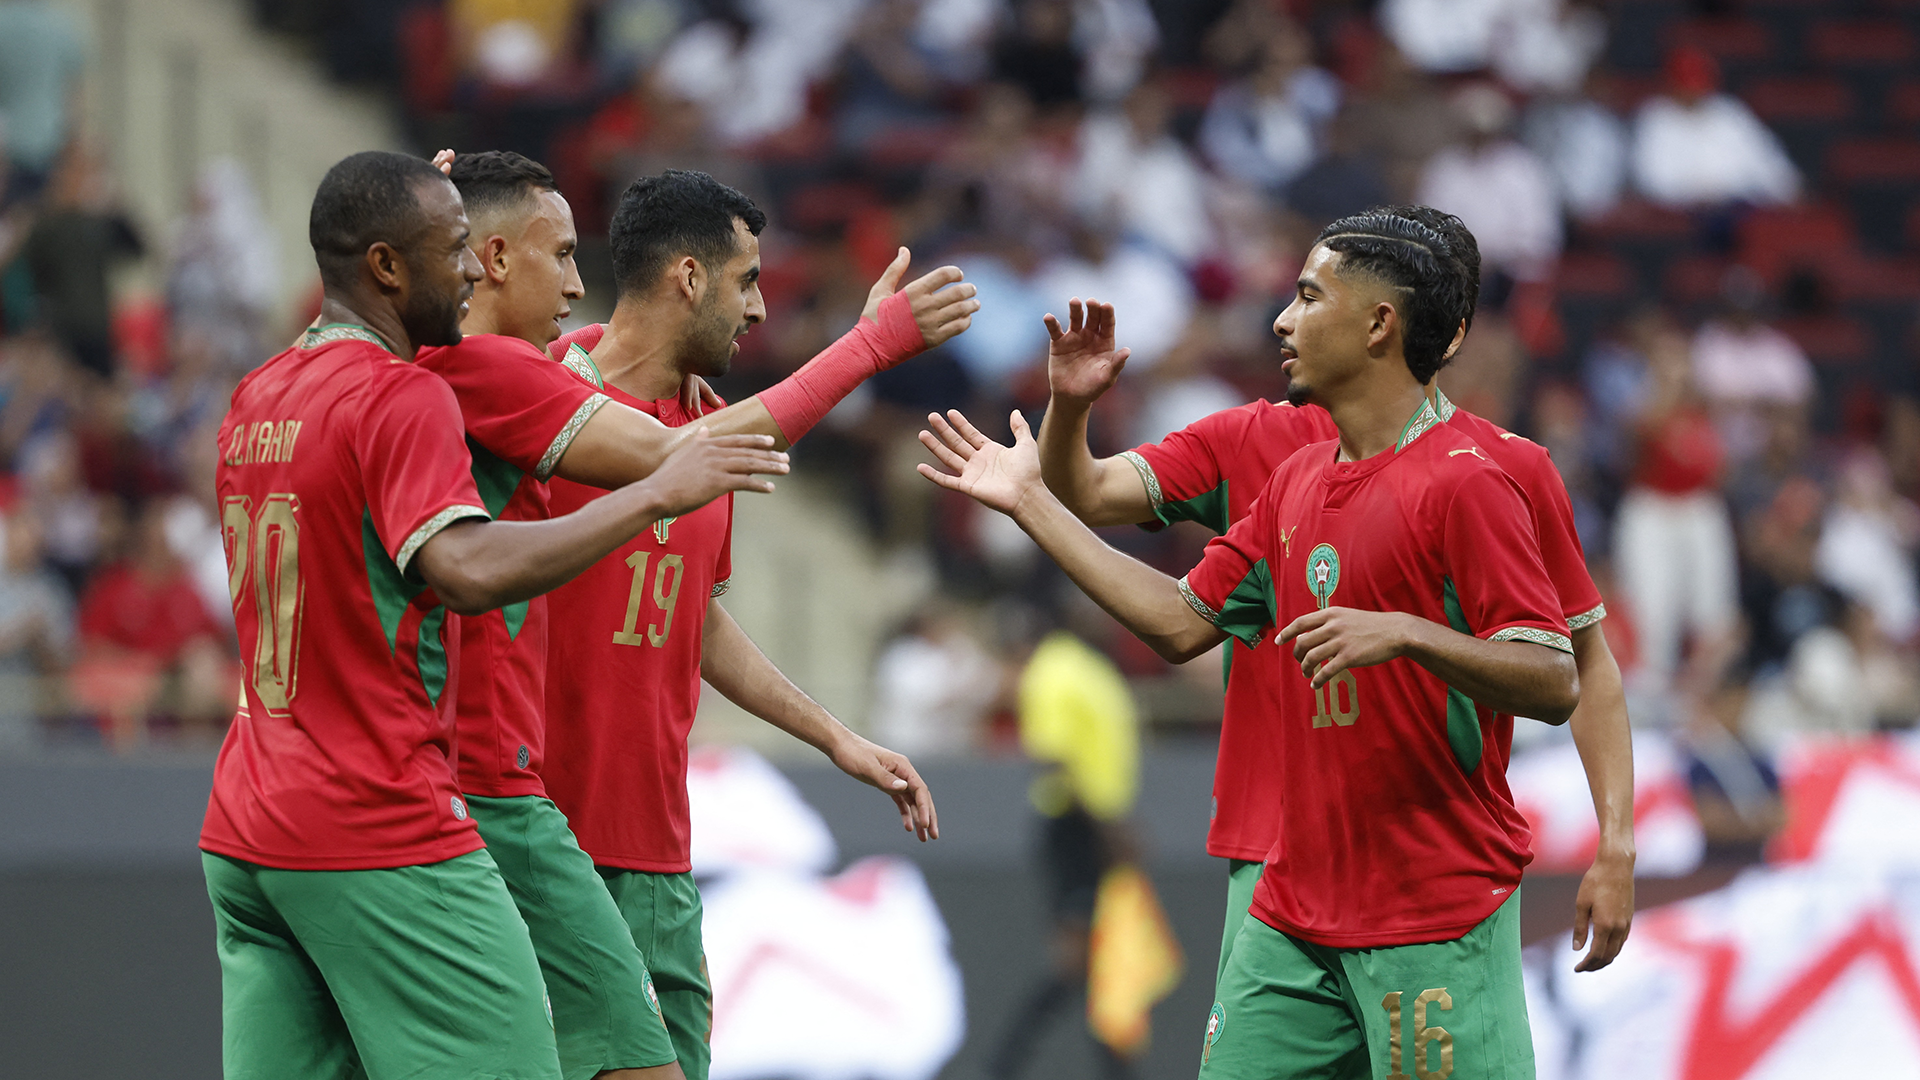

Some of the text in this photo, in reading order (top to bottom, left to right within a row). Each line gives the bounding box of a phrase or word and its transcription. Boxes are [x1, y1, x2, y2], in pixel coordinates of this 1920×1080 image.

[245, 420, 302, 464] KAABI
[612, 550, 685, 648] 19
[1381, 987, 1454, 1080] 16
